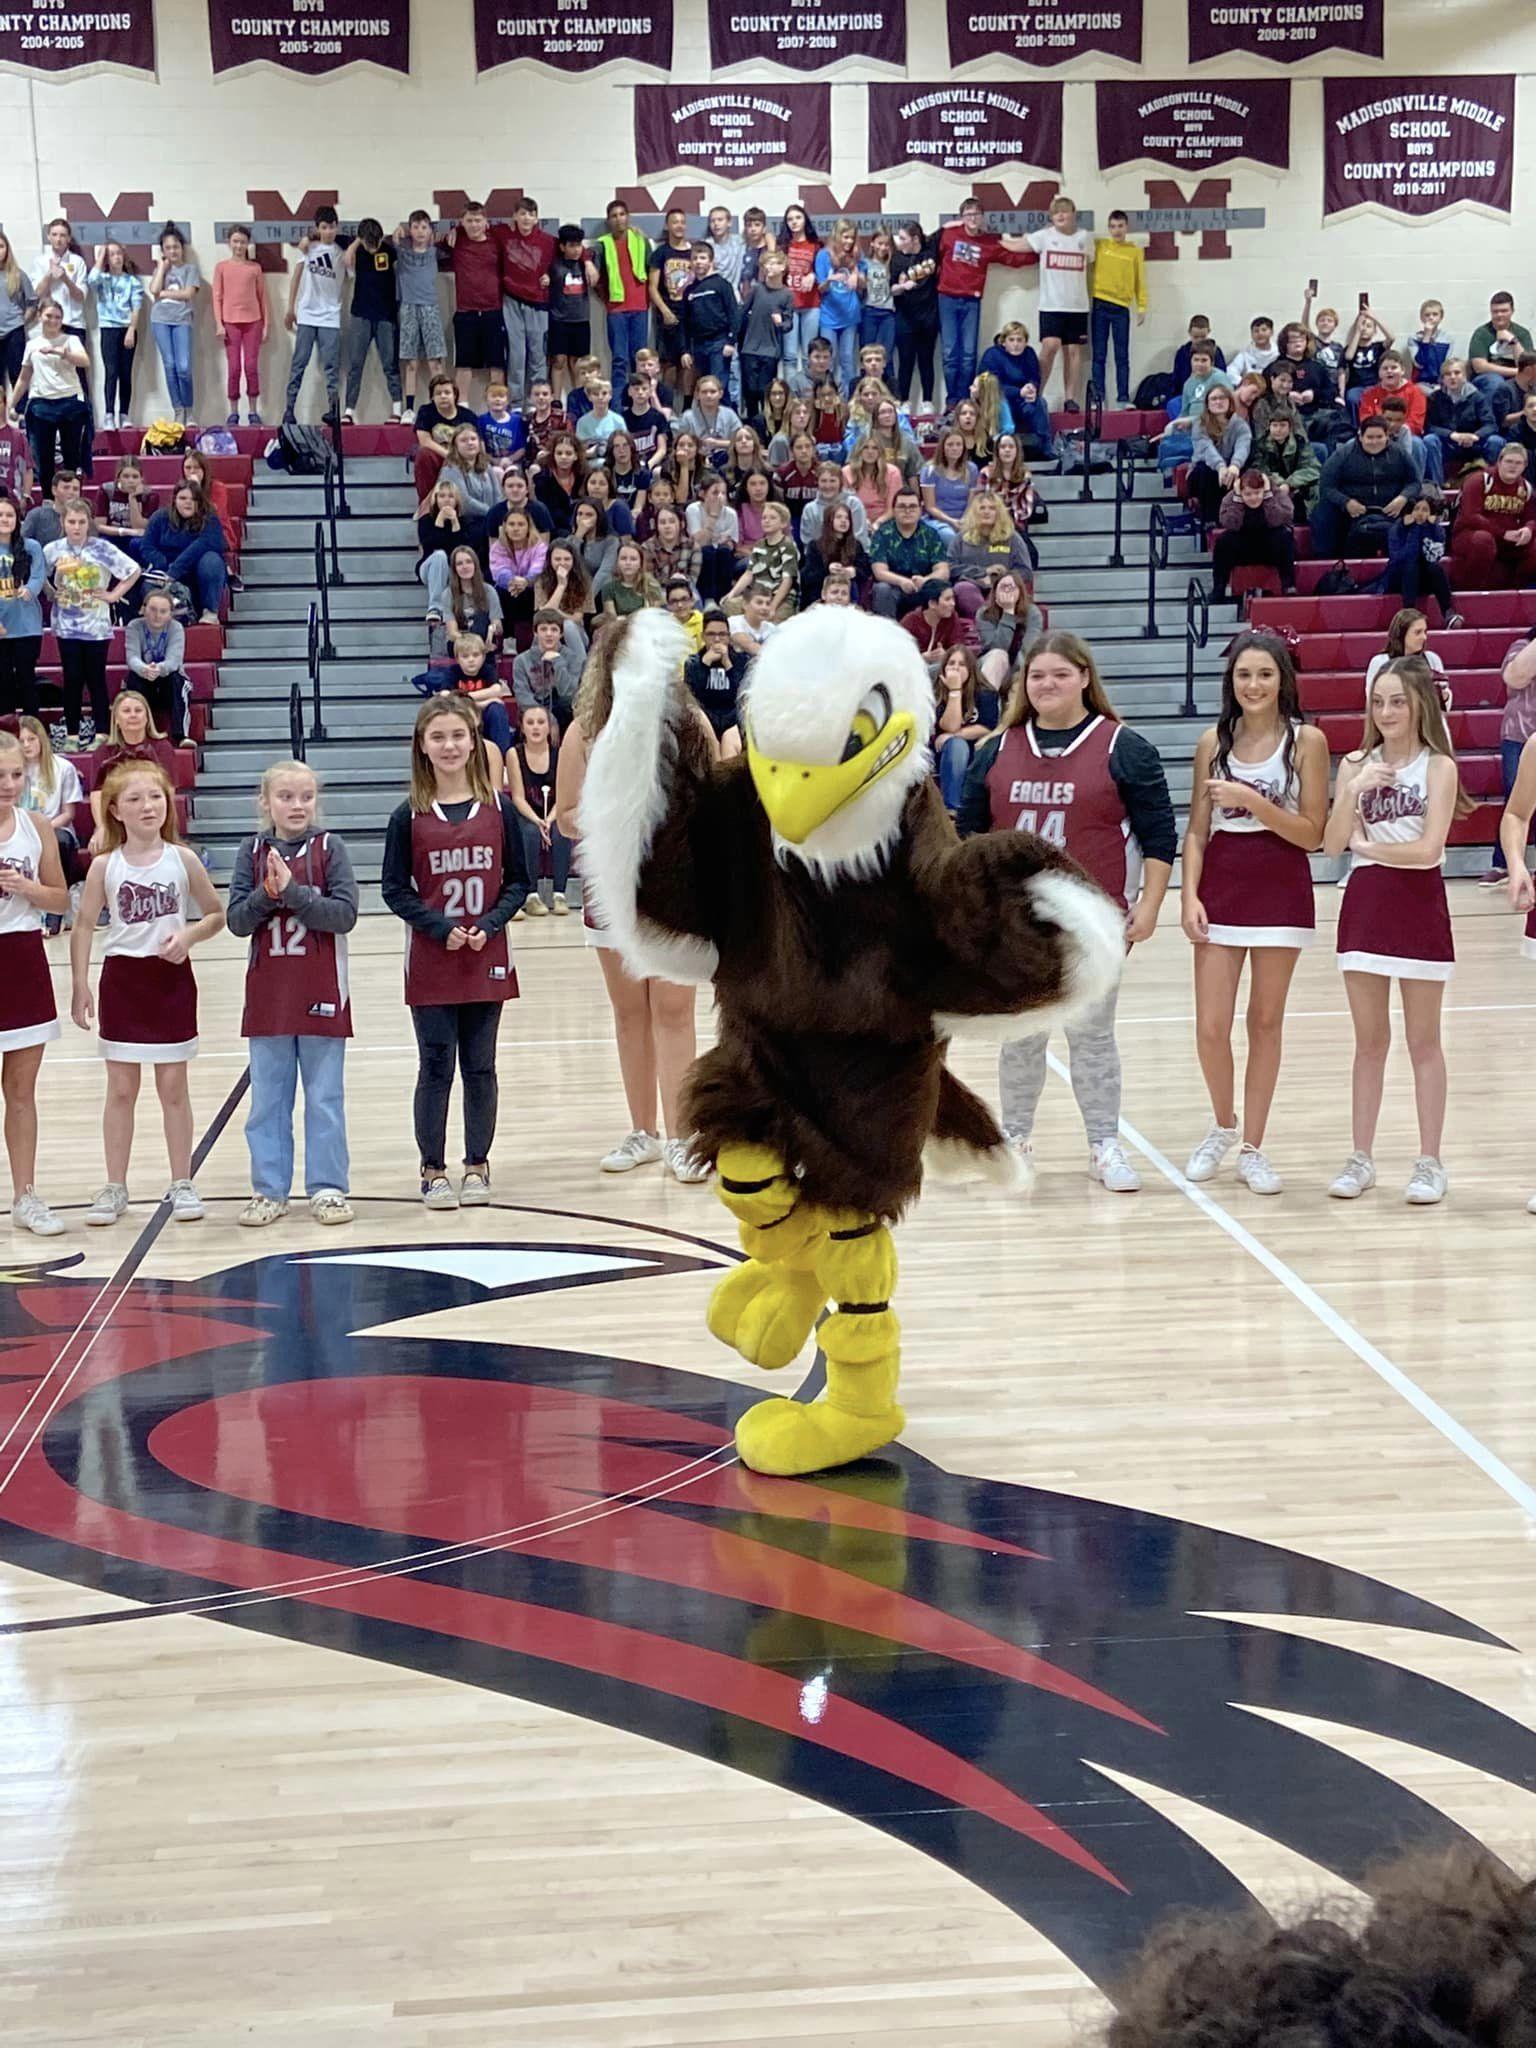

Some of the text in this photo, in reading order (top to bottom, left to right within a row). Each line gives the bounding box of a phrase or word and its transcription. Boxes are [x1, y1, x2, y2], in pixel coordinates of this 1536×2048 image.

[292, 0, 325, 12] BOYS
[557, 0, 588, 11] BOYS
[1210, 4, 1364, 25] COUNTY CHAMPIONS
[39, 13, 131, 31] CHAMPIONS
[231, 18, 391, 36] COUNTY CHAMPIONS
[497, 17, 652, 36] COUNTY CHAMPIONS
[730, 13, 884, 32] COUNTY CHAMPIONS
[968, 13, 1122, 32] COUNTY CHAMPIONS
[20, 35, 84, 49] 2004-2005
[543, 39, 604, 53] 2006-2007
[777, 36, 837, 49] 2007-2008
[671, 94, 792, 123] MADISONVILLE MIDDLE
[899, 89, 1030, 120] MADISONVILLE MIDDLE
[1137, 91, 1250, 118] MADISONVILLE MIDDLE
[709, 113, 755, 127] SCHOOL
[940, 110, 988, 124] SCHOOL
[1172, 109, 1215, 121] SCHOOL
[1336, 94, 1506, 135] MADISONVILLE MIDDLE
[1389, 121, 1451, 139] SCHOOL
[678, 140, 787, 155] COUNTY CHAMPIONS
[905, 140, 1024, 155] COUNTY CHAMPIONS
[1142, 136, 1244, 148] COUNTY CHAMPIONS
[1406, 142, 1434, 156] BOYS
[1343, 160, 1496, 180] COUNTY CHAMPIONS
[1392, 181, 1446, 196] 2010-2011
[1009, 780, 1076, 806] EAGLES
[428, 845, 494, 875] EAGLES
[442, 875, 484, 918] 20
[267, 915, 307, 957] 12
